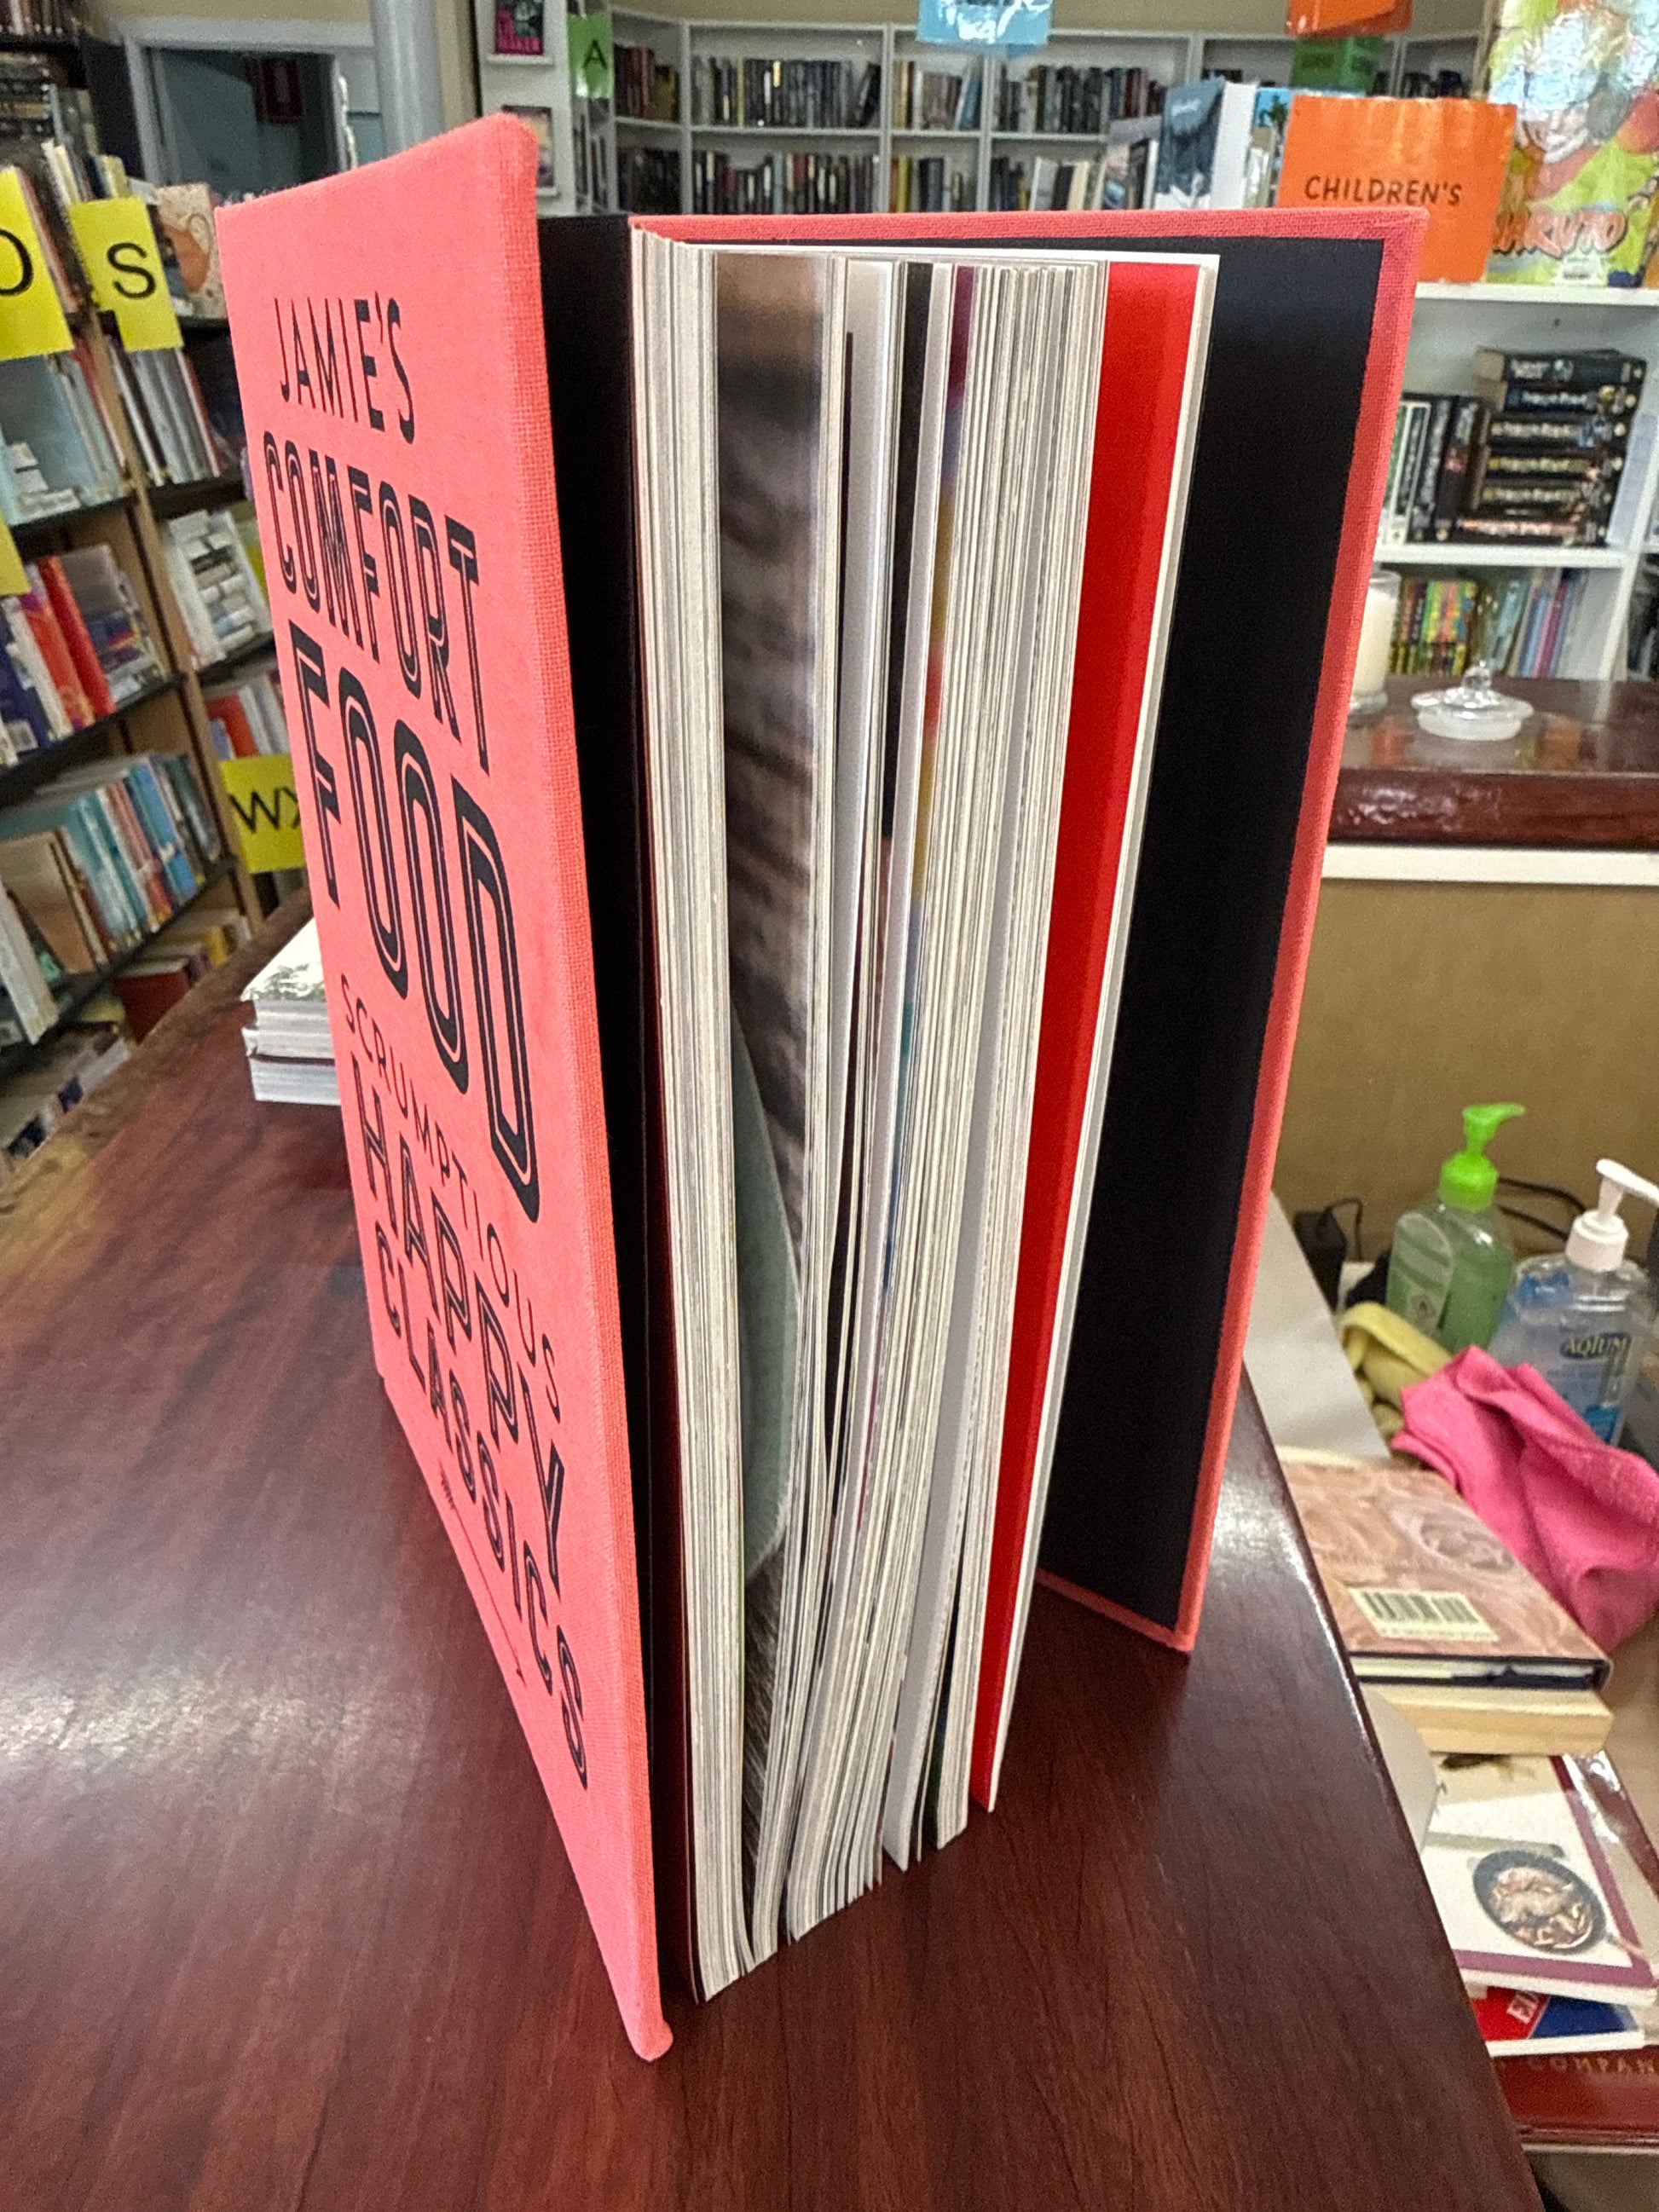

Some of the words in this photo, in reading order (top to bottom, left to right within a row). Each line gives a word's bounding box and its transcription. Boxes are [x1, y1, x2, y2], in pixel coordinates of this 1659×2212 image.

[582, 38, 608, 70] A
[1304, 175, 1463, 206] CHILDREN'S
[107, 242, 155, 298] S
[274, 291, 415, 445] JAMIE'S
[263, 430, 490, 777] COMFORT
[287, 618, 540, 1224] FOOD
[340, 973, 561, 1424] SCRUMPTIOUS
[350, 1051, 565, 1603] HAPPY
[374, 1220, 588, 1792] CLASSICS
